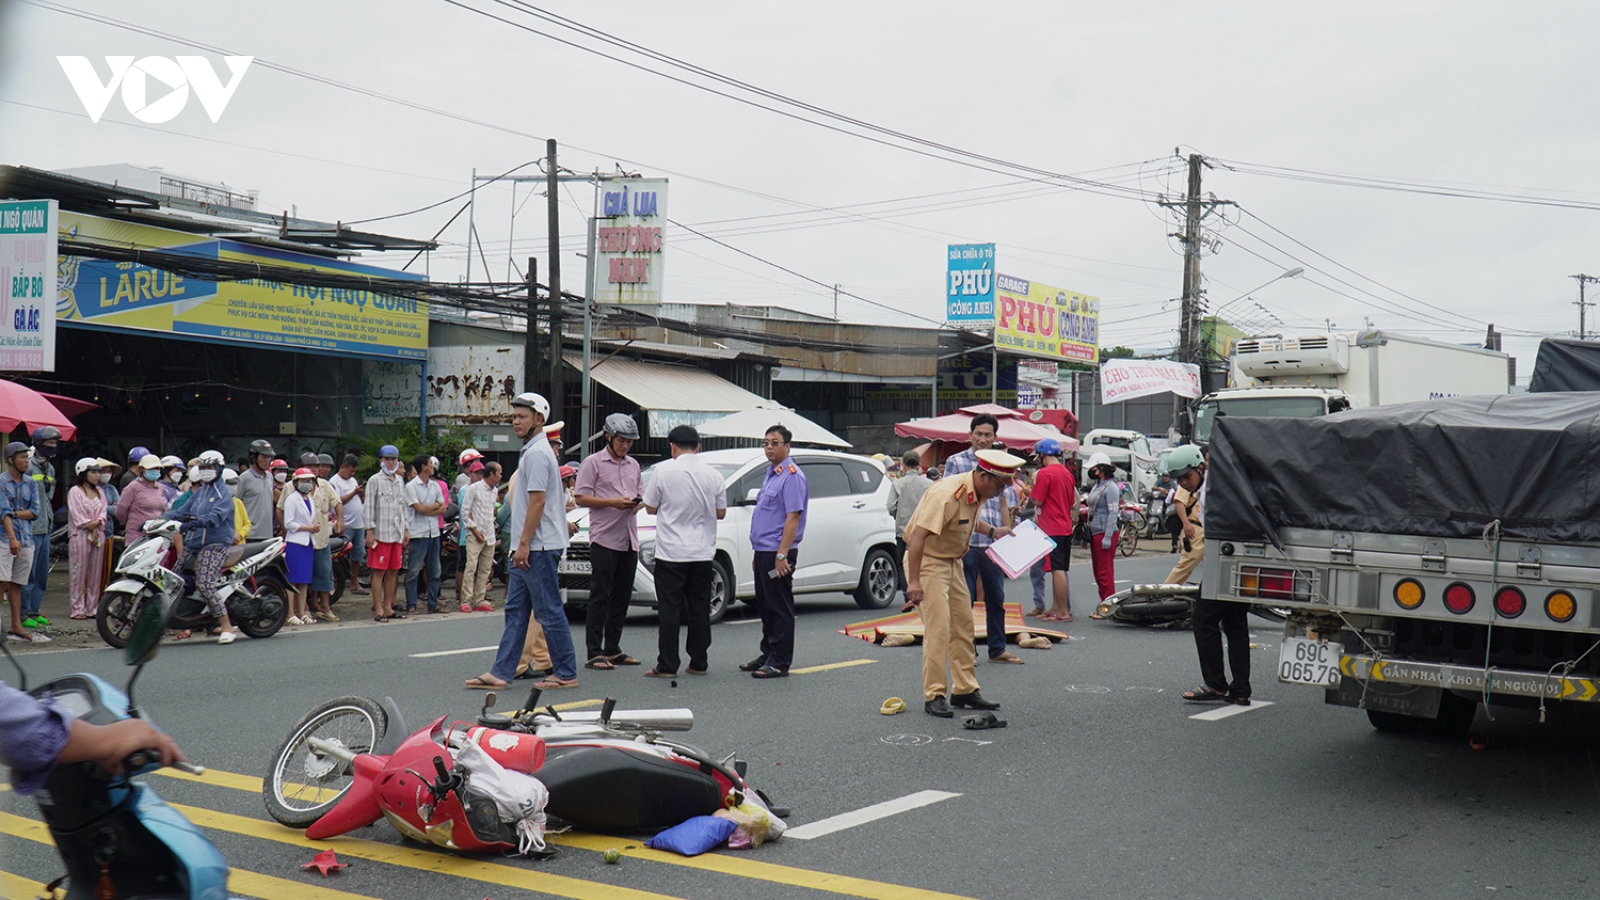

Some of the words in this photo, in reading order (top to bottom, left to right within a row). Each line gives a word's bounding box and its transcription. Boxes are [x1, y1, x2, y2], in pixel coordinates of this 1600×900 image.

[603, 185, 629, 218] CHẢ
[633, 191, 659, 221] LỤA
[4, 206, 20, 232] NGỘ
[22, 206, 44, 231] QUÁN
[949, 247, 961, 260] SỬA
[962, 247, 977, 259] CHỮA
[978, 247, 984, 259] Ô
[984, 247, 993, 259] TÔ
[608, 257, 649, 284] NAM
[949, 262, 993, 296] PHÚ
[13, 268, 29, 298] BẮP
[31, 272, 42, 298] BÒ
[100, 269, 186, 308] LARUE
[997, 277, 1028, 295] GARAGE
[14, 305, 26, 332] GÀ
[27, 304, 40, 332] ÁC
[949, 299, 972, 315] (CÔNG
[973, 301, 993, 315] ANH)
[999, 297, 1056, 339] PHÚ
[940, 358, 973, 369] AGE
[1105, 367, 1130, 384] CHO
[1296, 642, 1328, 663] 69C
[1281, 661, 1339, 684] 065.76
[1410, 669, 1443, 682] NHAU
[1476, 677, 1500, 690] LM
